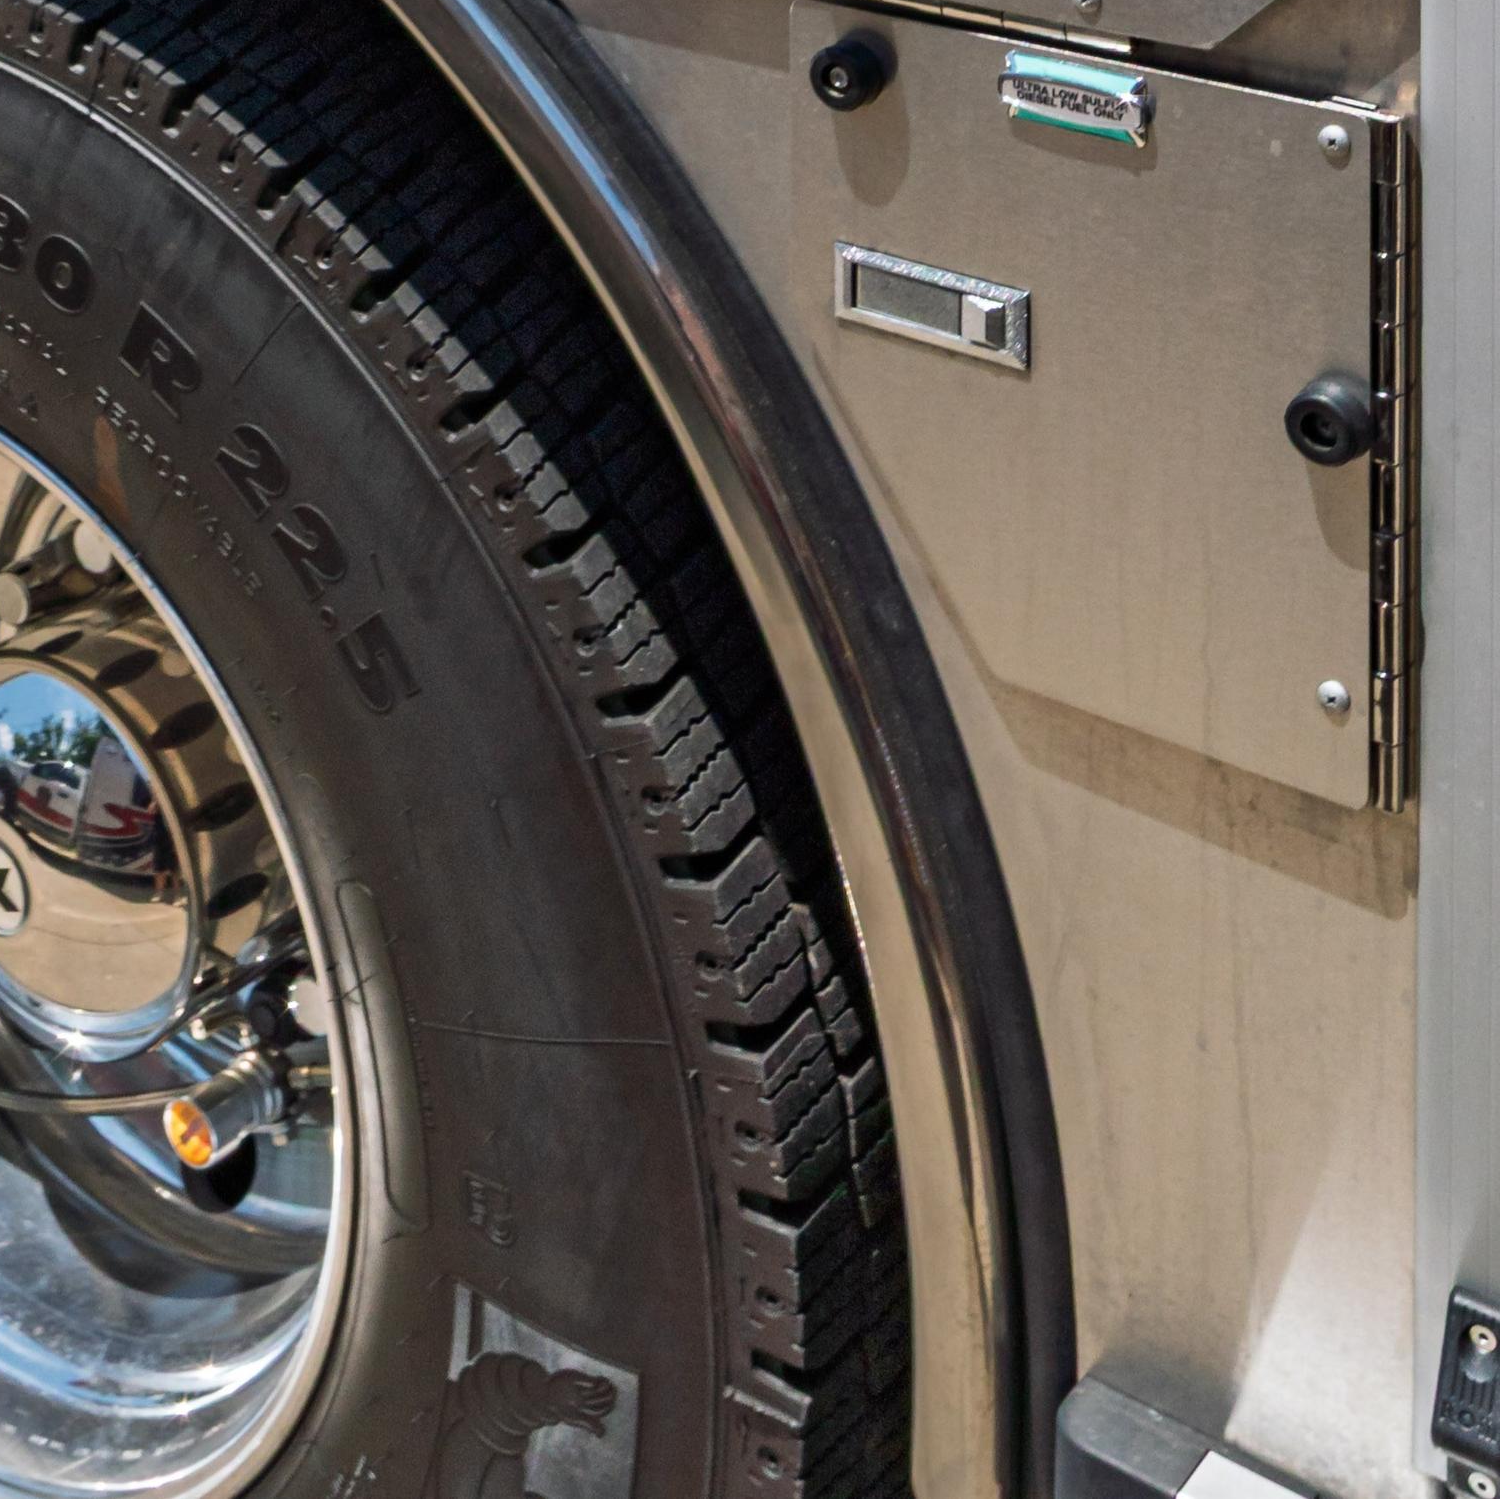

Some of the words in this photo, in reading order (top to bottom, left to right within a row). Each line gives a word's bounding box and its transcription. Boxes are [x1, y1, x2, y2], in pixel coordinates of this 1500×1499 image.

[1012, 78, 1049, 95] ULTRA
[1052, 88, 1078, 102] LOW
[1016, 89, 1058, 108] DIESEL
[1061, 100, 1090, 116] FUEL
[1094, 106, 1125, 121] ONLY
[212, 421, 424, 717] 22.5
